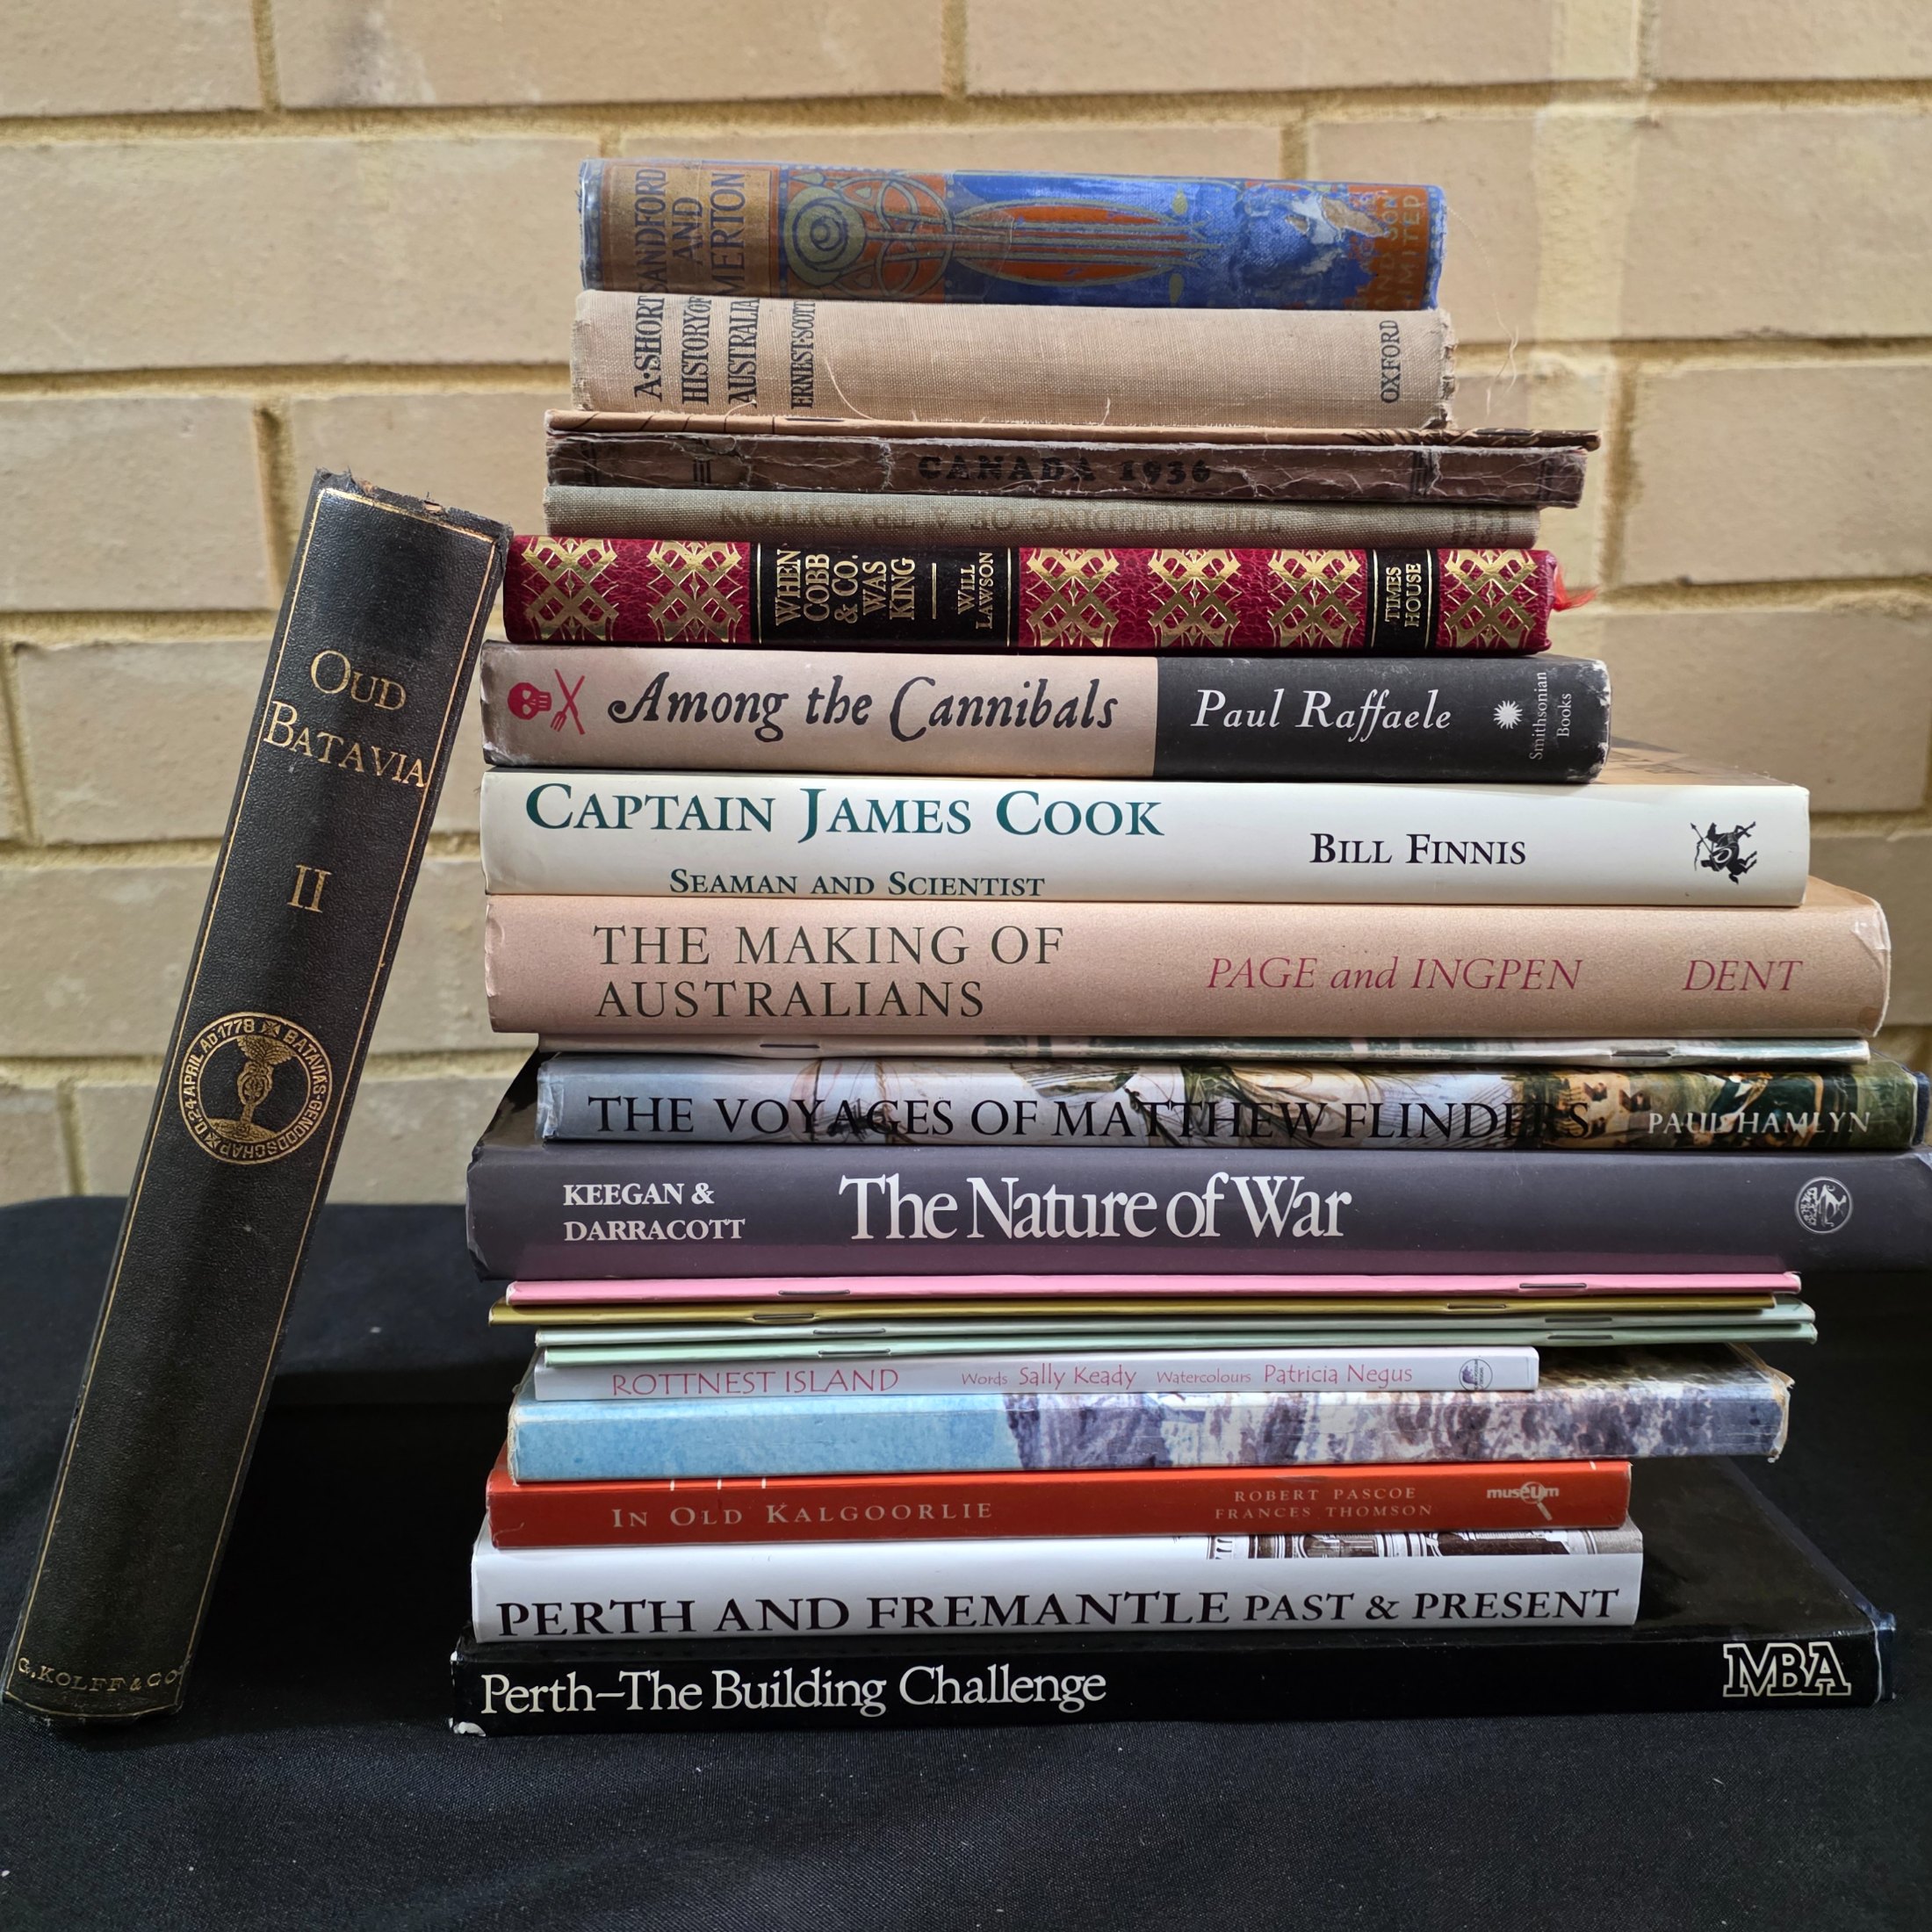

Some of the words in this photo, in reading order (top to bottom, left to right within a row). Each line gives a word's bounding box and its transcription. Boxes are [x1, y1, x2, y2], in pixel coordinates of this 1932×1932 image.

[635, 169, 668, 293] SANDFORD
[672, 197, 703, 264] AND
[710, 172, 746, 297] MERTON
[727, 299, 761, 408] AUSTRALIA
[1379, 320, 1401, 403] OXFORD
[918, 455, 1096, 482] CANADA
[1119, 458, 1210, 484] 1936
[775, 550, 801, 626] WHEN
[803, 553, 830, 621] COBB
[834, 604, 858, 624] &
[862, 561, 886, 616] WAS
[889, 558, 916, 620] KING
[957, 564, 976, 615] WILL
[976, 551, 994, 629] LAWSON
[1385, 566, 1402, 622] TIMES
[1404, 563, 1422, 627] HOUSE
[310, 649, 407, 710] OUD
[608, 671, 789, 742] Among
[805, 674, 873, 725] the
[890, 675, 1119, 742] Cannibals
[1191, 688, 1285, 728] Paul
[1295, 688, 1452, 743] Raffaele
[1529, 671, 1547, 761] Smithsonian
[1556, 692, 1572, 738] Books
[263, 700, 428, 788] BATAVIA
[526, 782, 776, 833] CAPTAIN
[797, 788, 972, 843] JAMES
[996, 789, 1165, 836] COOK
[1310, 833, 1394, 865] BILL
[1405, 833, 1526, 866] FINNIS
[287, 864, 333, 913] II
[669, 869, 798, 894] SEAMAN
[810, 876, 875, 896] AND
[888, 870, 1045, 897] SCIENTIST
[594, 925, 710, 965] THE
[735, 925, 970, 965] MAKING
[990, 925, 1064, 965] OF
[595, 980, 984, 1019] AUSTRALIANS
[1207, 956, 1318, 990] PAGE
[1330, 957, 1400, 991] and
[1410, 958, 1582, 991] INGPEN
[1683, 959, 1803, 992] DENT
[183, 1052, 204, 1094] APRIL
[217, 1019, 255, 1039] 1778
[588, 1095, 694, 1134] THE
[714, 1098, 954, 1137] VOYAGES
[971, 1099, 1038, 1136] OF
[1055, 1100, 1327, 1139] MATTHEW
[1344, 1101, 1589, 1140] FLINDERS
[1647, 1111, 1722, 1135] PAUL
[1737, 1111, 1871, 1135] HAMLYN
[563, 1183, 684, 1207] KEEGAN
[691, 1182, 715, 1205] &
[838, 1173, 958, 1241] The
[967, 1177, 1157, 1239] Nature
[1165, 1171, 1229, 1238] of
[1229, 1175, 1352, 1238] War
[564, 1218, 746, 1241] DARRACOTT
[612, 1371, 775, 1396] ROTTNEST
[785, 1368, 899, 1393] ISLAND
[962, 1371, 1008, 1386] Words
[1019, 1362, 1065, 1390] Sally
[1074, 1364, 1137, 1390] Keady
[1157, 1368, 1251, 1385] Watercolours
[1264, 1364, 1338, 1385] Patricia
[1346, 1364, 1413, 1389] Negus
[767, 1503, 991, 1525] KALGOORLIE
[1215, 1507, 1311, 1519] FRANCES
[1325, 1505, 1432, 1518] THOMSON
[1234, 1489, 1320, 1503] ROBERT
[1334, 1487, 1417, 1500] PASCOE
[496, 1598, 696, 1636] PERTH
[713, 1597, 850, 1633] AND
[866, 1590, 1230, 1629] FREMANTLE
[1244, 1593, 1354, 1621] PAST
[1366, 1595, 1399, 1620] &
[1412, 1588, 1619, 1619] PRESENT
[711, 1667, 887, 1718] Building
[898, 1663, 1107, 1713] Challenge
[1722, 1641, 1851, 1698] MBA
